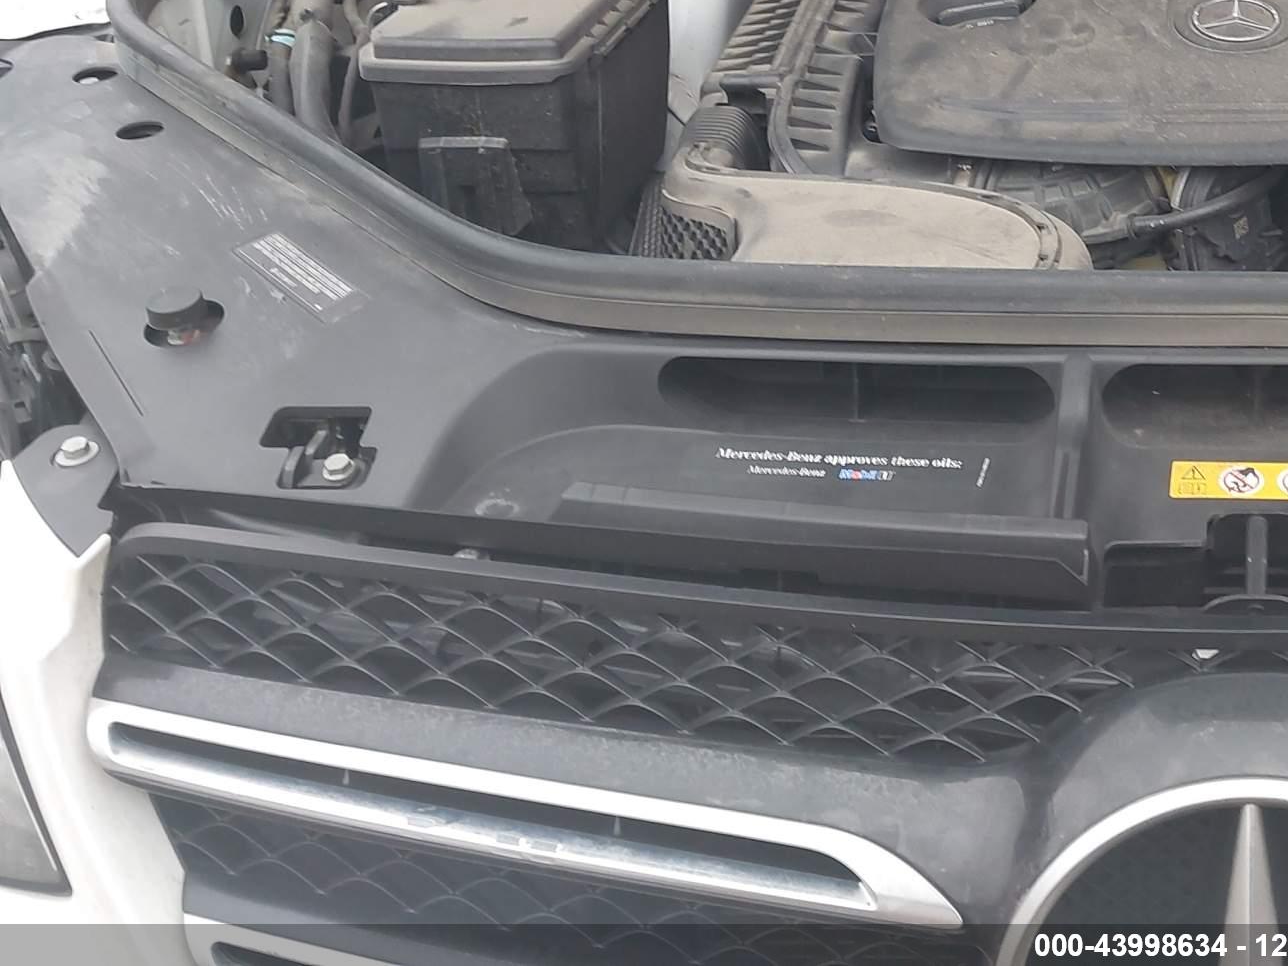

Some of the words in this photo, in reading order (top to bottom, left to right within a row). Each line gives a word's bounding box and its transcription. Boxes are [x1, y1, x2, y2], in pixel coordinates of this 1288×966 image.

[715, 447, 823, 464] Mercedes-Benz
[823, 454, 889, 467] approves
[890, 456, 930, 469] these
